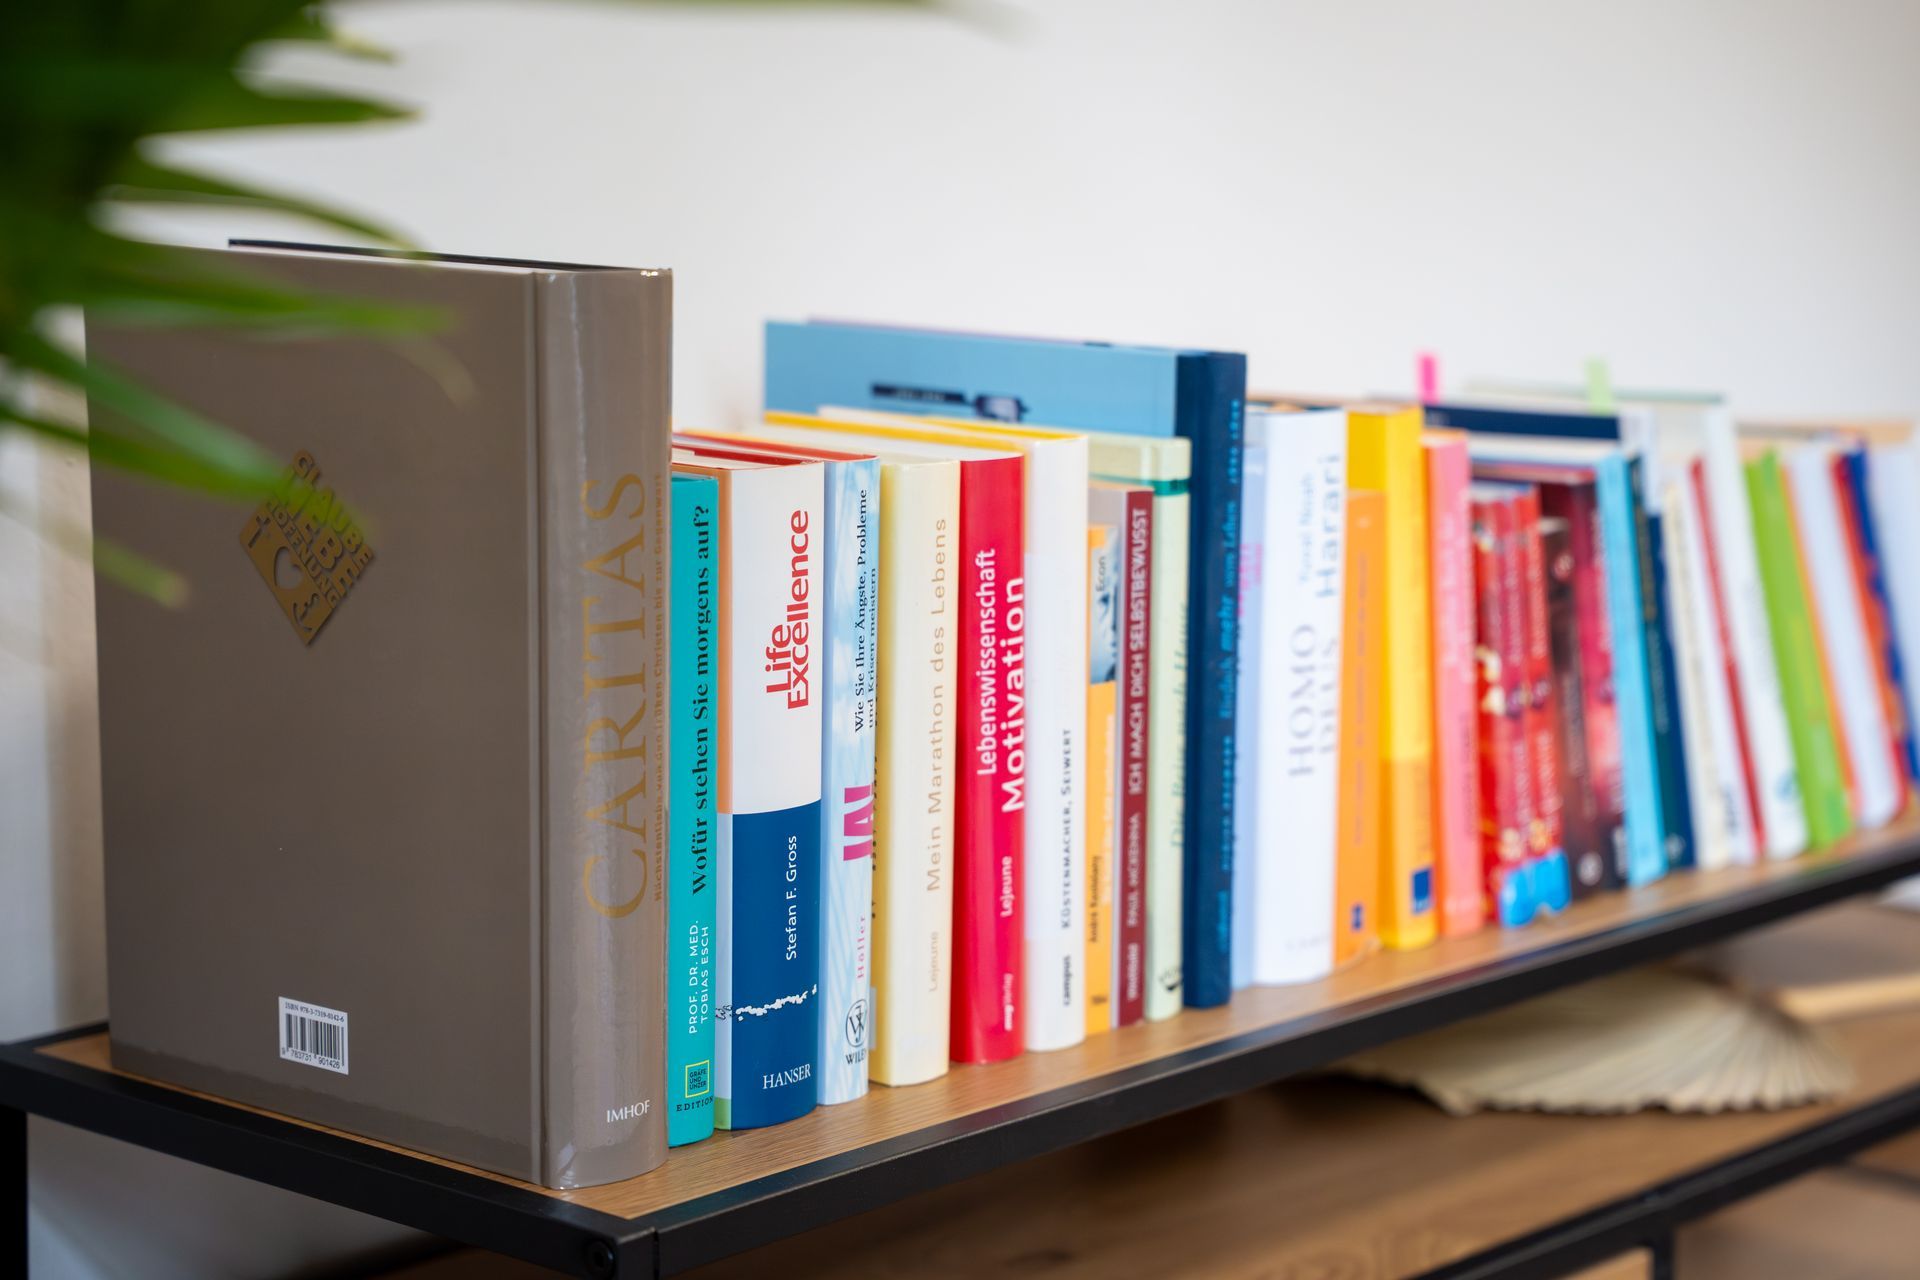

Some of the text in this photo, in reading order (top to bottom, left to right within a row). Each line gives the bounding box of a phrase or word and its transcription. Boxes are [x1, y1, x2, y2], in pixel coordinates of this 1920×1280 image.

[1096, 556, 1107, 592] Econ
[1314, 451, 1341, 598] Harari
[652, 613, 663, 676] Christen
[765, 624, 793, 693] Life
[786, 510, 808, 709] Excellence
[855, 489, 867, 732] Wie Sie Ihre Ängste, Probleme
[867, 567, 877, 728] und Krisen meistern
[975, 549, 997, 775] Lebenswissenschaft
[1128, 509, 1148, 796] ICH MACH DICH SELBSTBEWUSST
[582, 473, 648, 918] CARITAS
[691, 505, 711, 895] Wofür stehen Sie morgens auf?
[926, 518, 946, 891] Mein Marathon des Lebens
[1000, 577, 1024, 812] Motivation
[1061, 728, 1072, 796] SEIWERT
[1287, 622, 1317, 777] HOMO
[785, 835, 797, 961] Stefan F. Gross
[1000, 855, 1015, 918] Lejeune
[688, 920, 698, 1034] PROF. DR. MED.
[700, 926, 709, 1024] TOBIAS ESCH
[1062, 955, 1072, 1006] campus
[606, 1099, 651, 1123] IMHOF
[763, 1063, 811, 1090] HANSER
